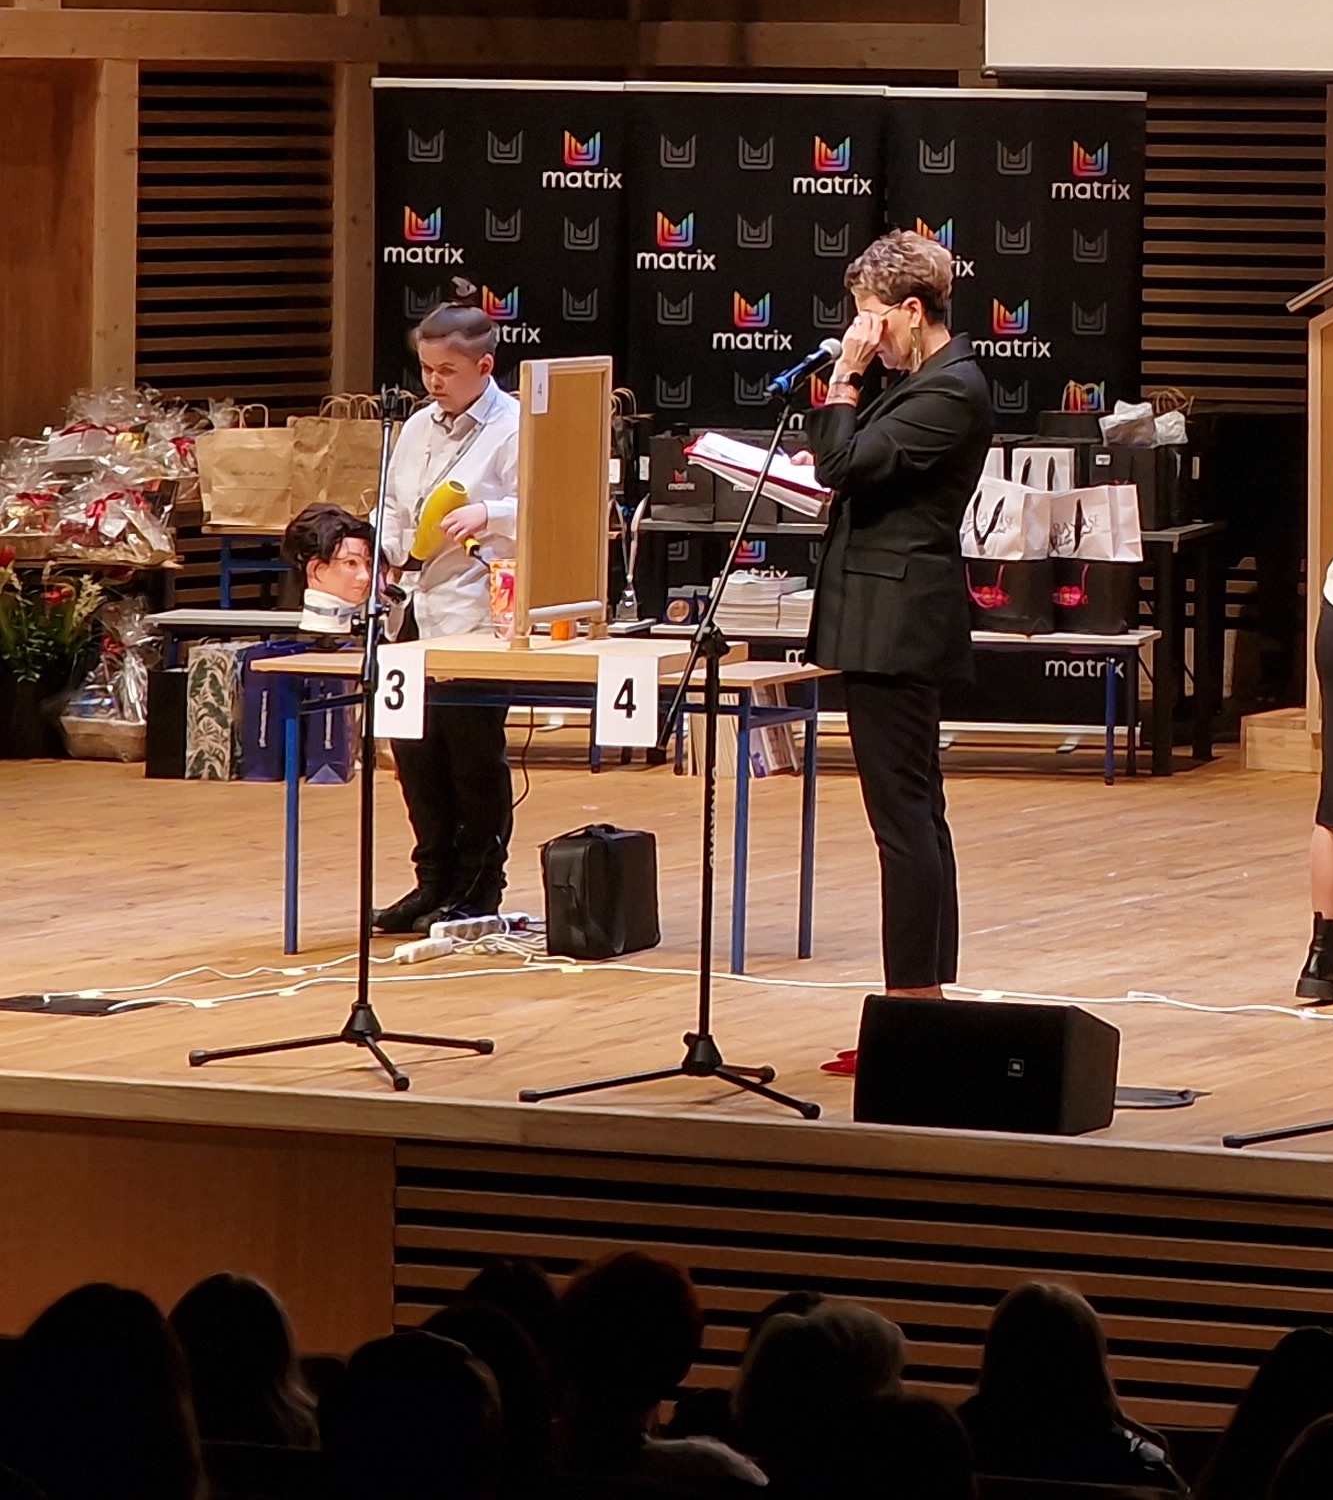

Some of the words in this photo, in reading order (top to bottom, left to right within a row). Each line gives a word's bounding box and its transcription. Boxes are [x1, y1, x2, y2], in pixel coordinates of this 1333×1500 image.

[542, 168, 622, 190] matrix
[793, 174, 872, 196] matrix
[1051, 179, 1130, 201] matrix
[383, 242, 464, 264] matrix
[636, 249, 716, 271] matrix
[712, 329, 792, 351] matrix
[971, 336, 1051, 358] matrix
[384, 669, 406, 711] 3
[613, 677, 637, 719] 4
